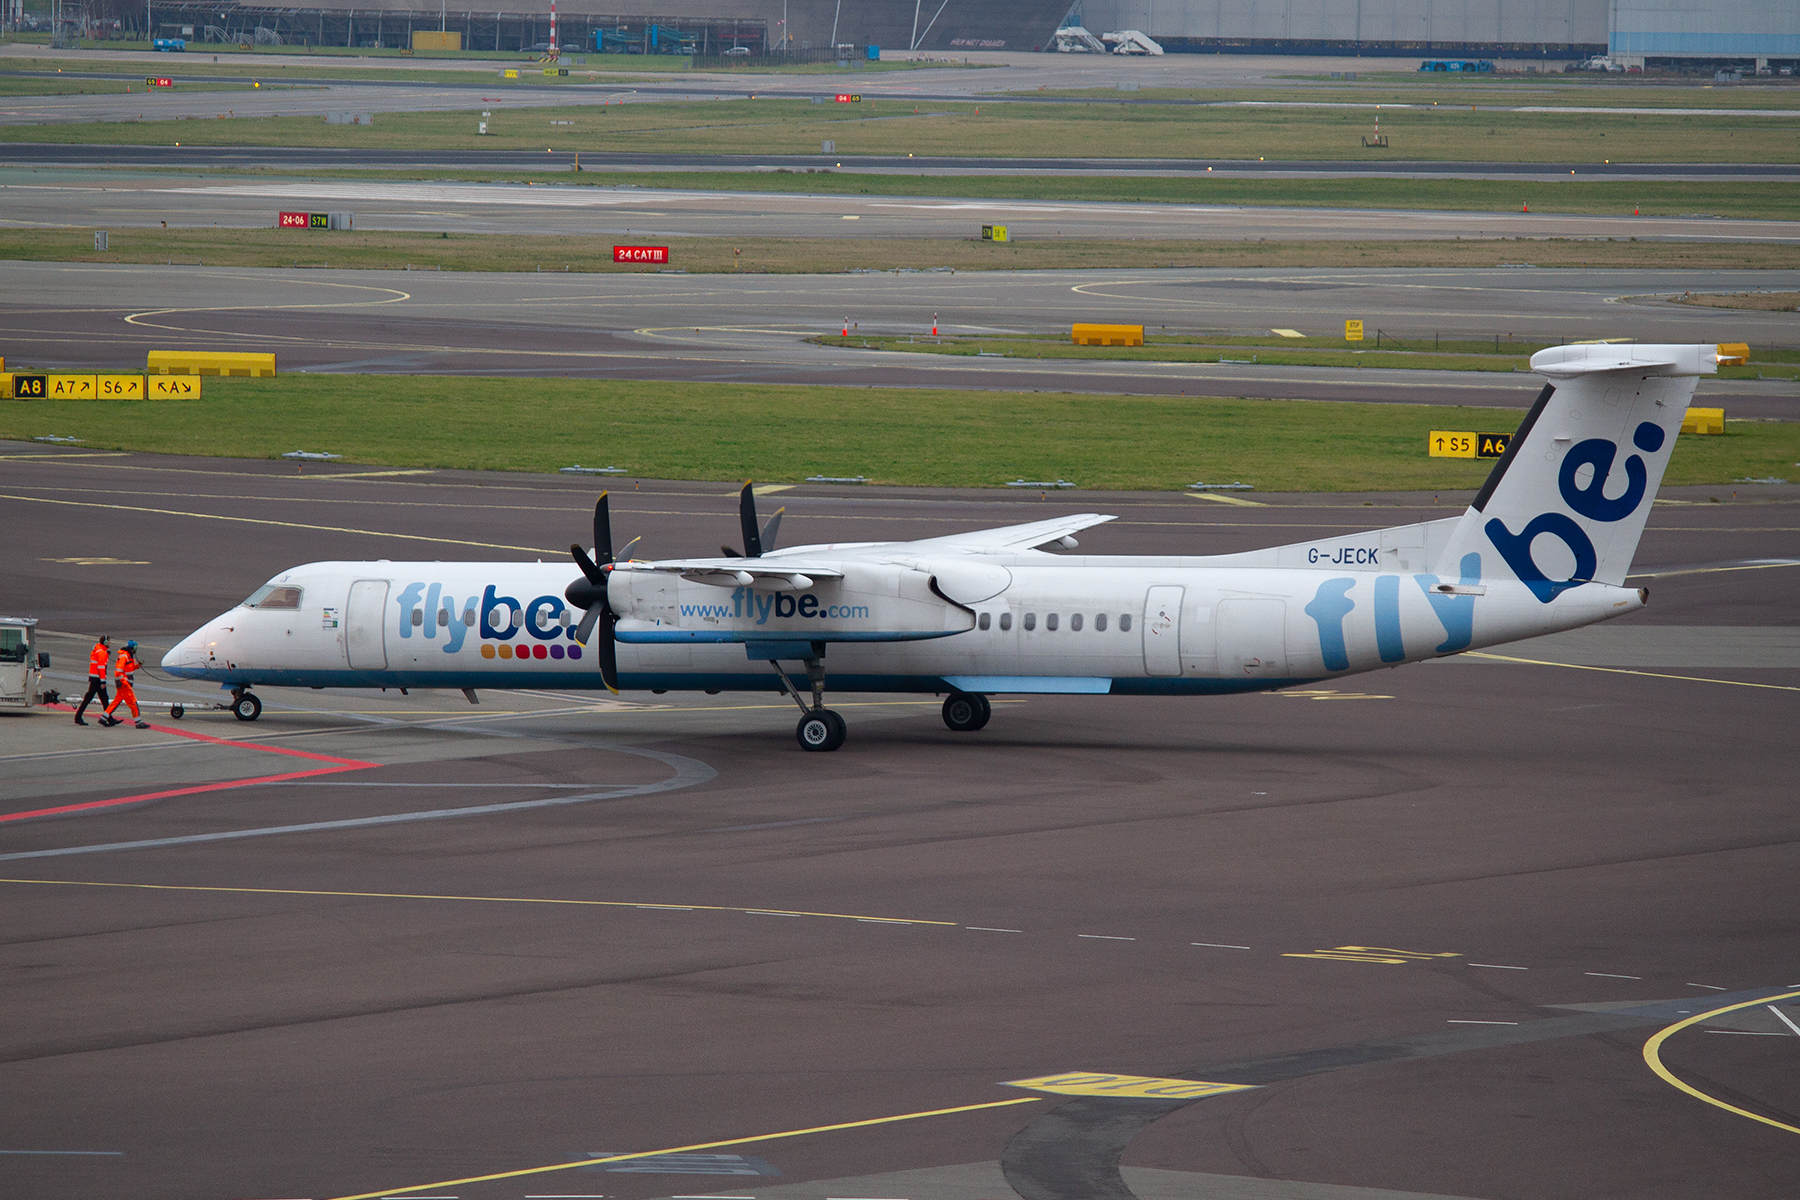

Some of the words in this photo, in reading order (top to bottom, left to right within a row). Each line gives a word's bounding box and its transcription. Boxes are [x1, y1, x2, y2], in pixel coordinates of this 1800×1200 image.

[312, 216, 327, 226] S7W
[618, 249, 632, 260] 24
[634, 249, 652, 260] CAT
[20, 380, 42, 394] A8
[55, 381, 75, 394] A7
[104, 381, 122, 394] S6
[169, 381, 180, 394] A
[1450, 437, 1470, 452] S5
[1482, 438, 1506, 453] A6
[1307, 547, 1379, 565] G-JECK
[680, 586, 869, 625] www.flybe.com
